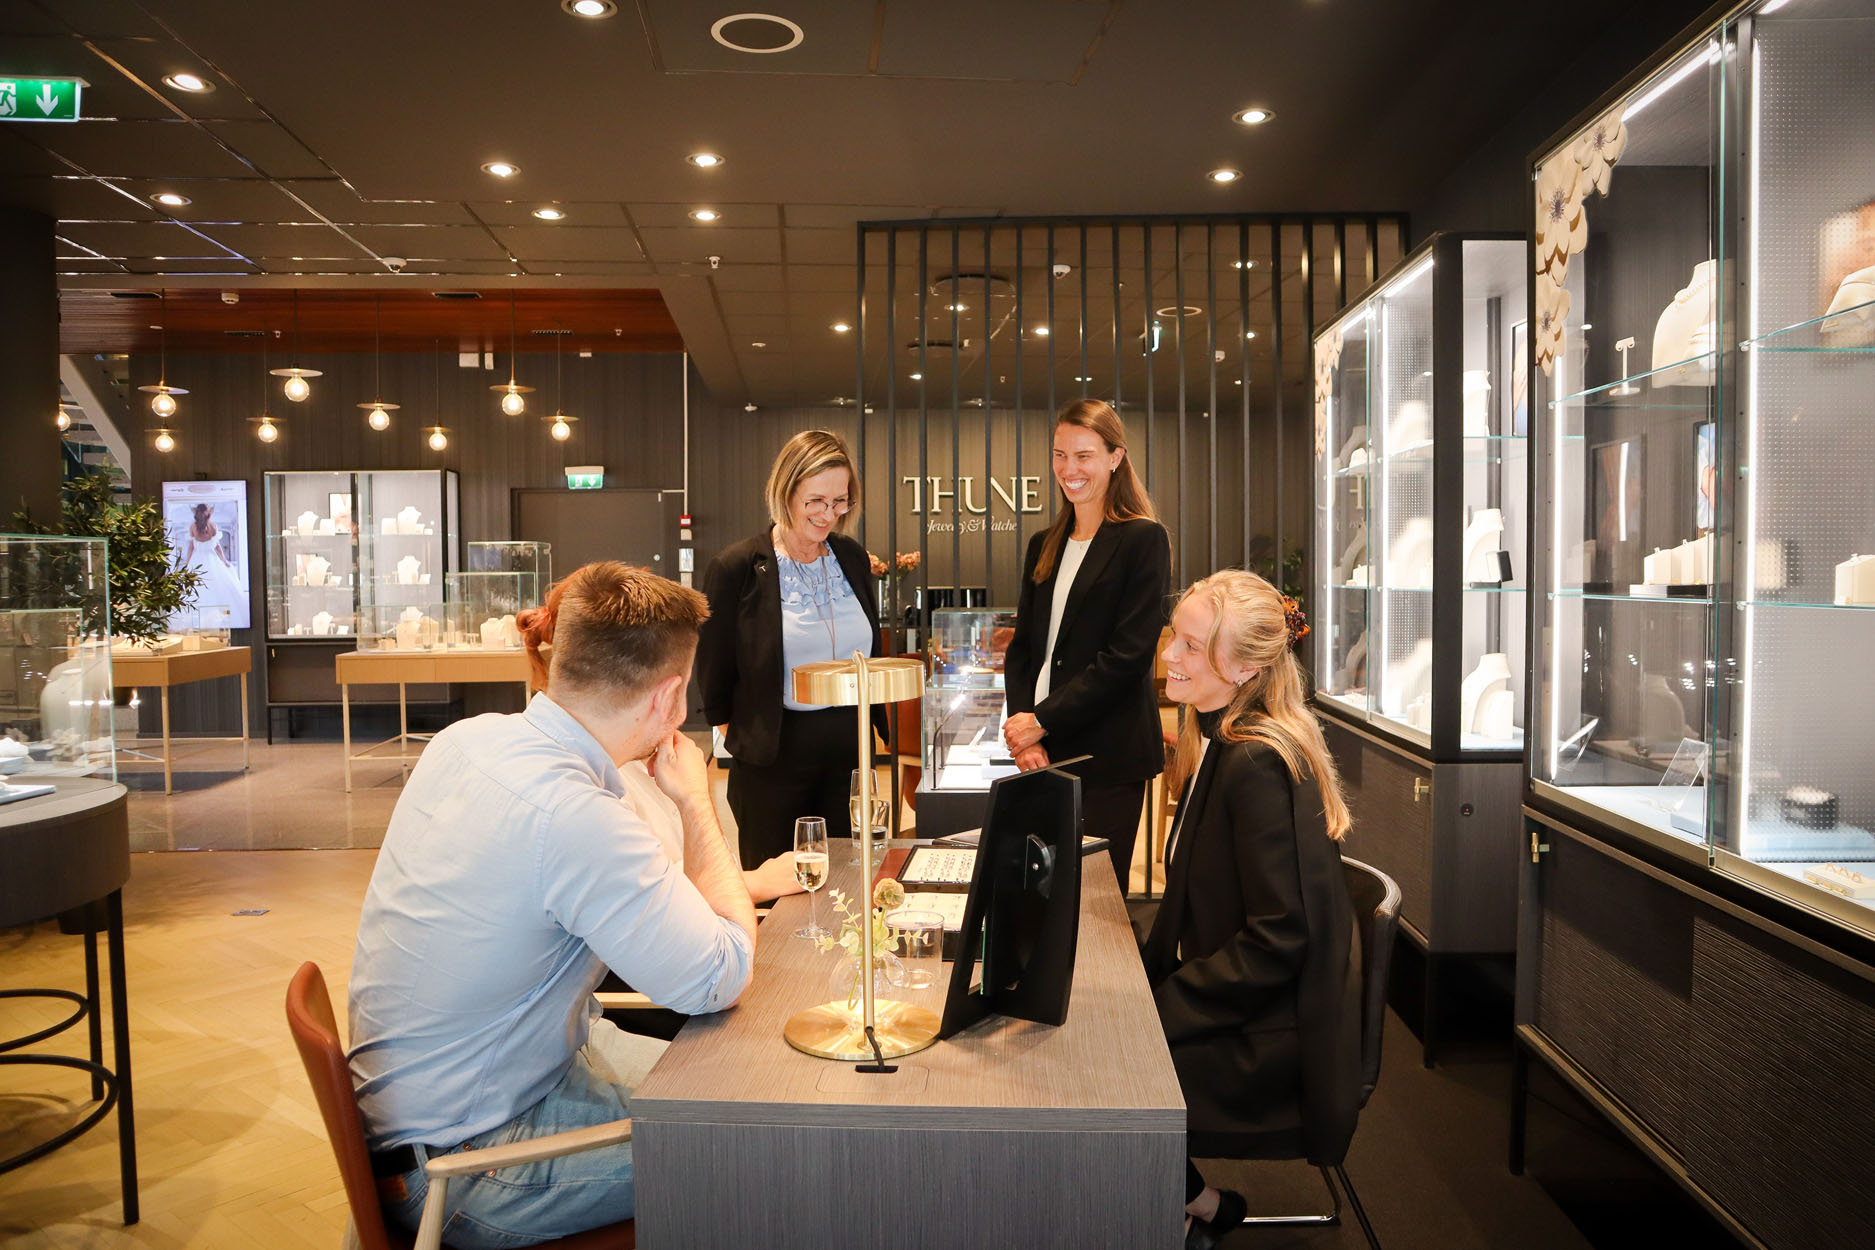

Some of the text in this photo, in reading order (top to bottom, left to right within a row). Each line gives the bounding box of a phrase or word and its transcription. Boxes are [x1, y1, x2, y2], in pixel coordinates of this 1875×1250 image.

[903, 476, 1043, 513] THUNE
[967, 519, 982, 532] &
[981, 516, 1018, 532] Watche
